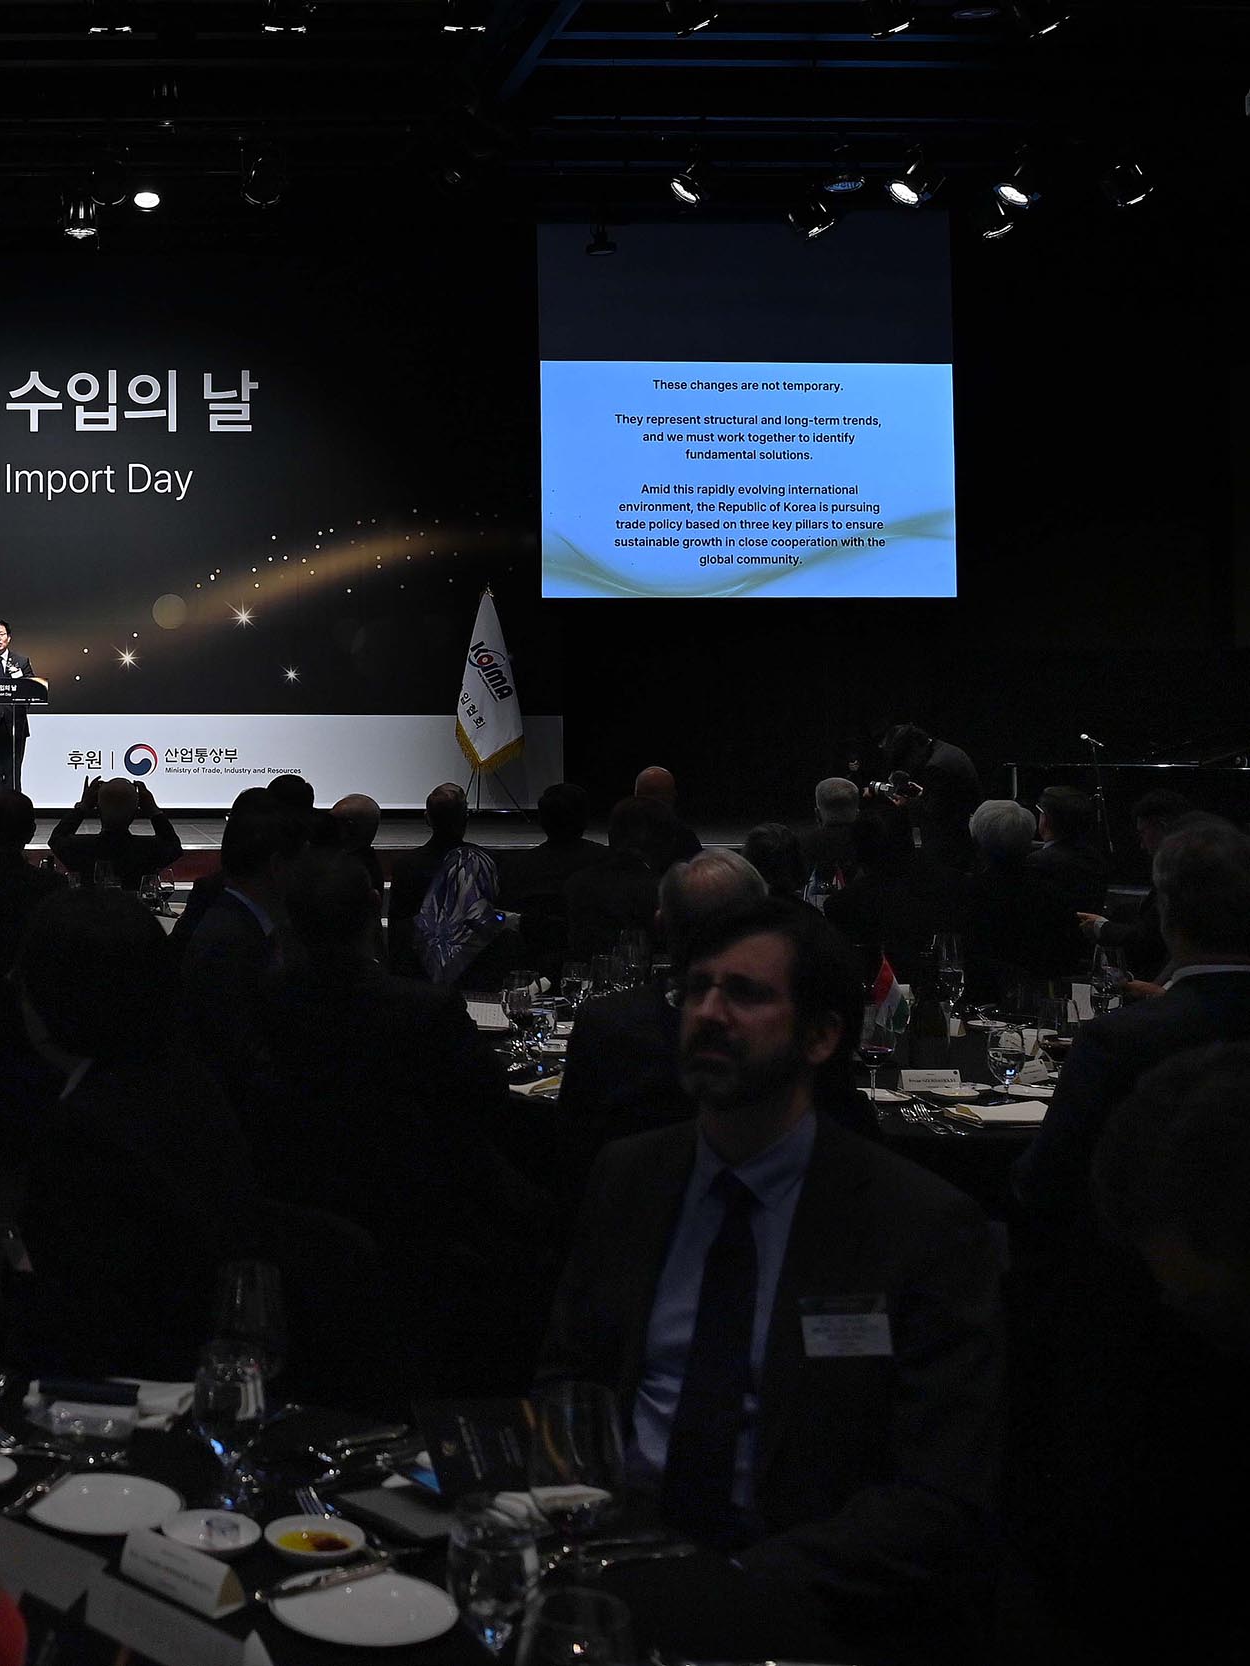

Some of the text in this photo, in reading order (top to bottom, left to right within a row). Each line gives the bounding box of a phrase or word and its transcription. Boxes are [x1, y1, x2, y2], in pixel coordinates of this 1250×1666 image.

[652, 379, 844, 394] These changes are not temporary.
[6, 369, 177, 433] 수입의
[203, 369, 259, 433] 날
[614, 413, 882, 428] They represent structural and long-term trends,
[642, 431, 855, 445] and we must work together to identify
[685, 448, 813, 461] fundamental solutions.
[6, 463, 116, 501] Import
[128, 463, 194, 501] Day
[641, 483, 859, 497] Amid this rapidly evolving international
[618, 501, 880, 515] environment, the Republic of Korea is pursuing
[615, 518, 884, 532] trade policy based on three key pillars to ensure
[614, 535, 886, 550] sustainable growth in close cooperation with the
[699, 553, 803, 567] global community.
[469, 640, 514, 702] KOIMA
[67, 750, 102, 770] 후원
[164, 747, 238, 764] 산업통상부
[165, 766, 302, 775] Ministry of Trade, Industry and Resources
